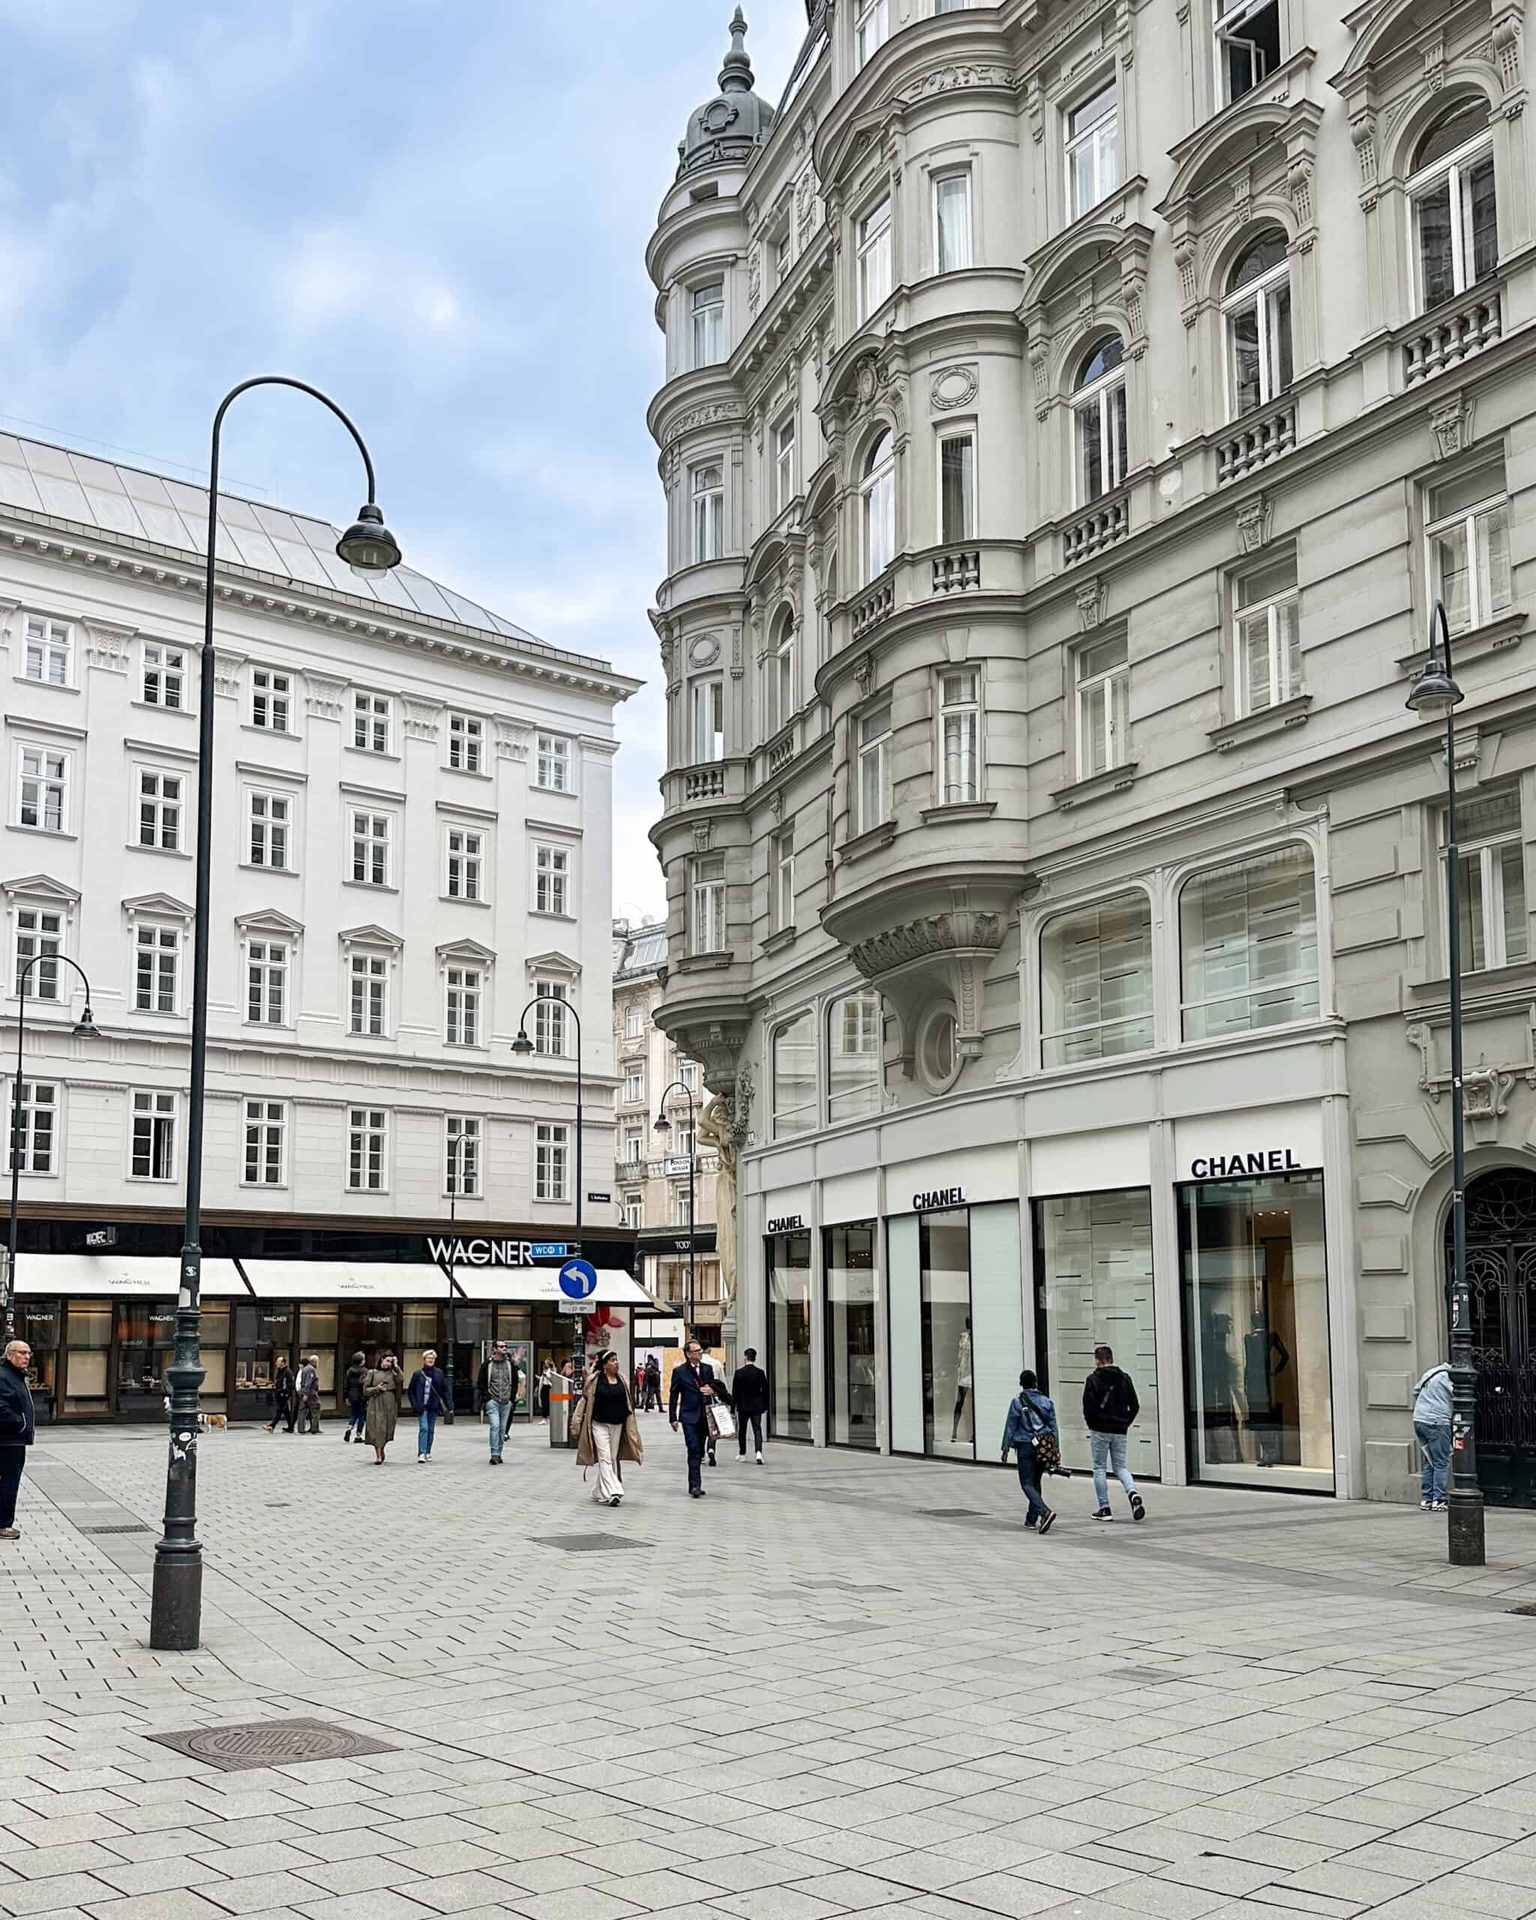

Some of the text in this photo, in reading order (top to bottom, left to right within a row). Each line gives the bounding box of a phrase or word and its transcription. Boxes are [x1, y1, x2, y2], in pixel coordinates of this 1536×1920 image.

[1190, 1149, 1301, 1178] CHANEL
[912, 1187, 966, 1210] CHANEL
[767, 1215, 804, 1233] CHANEL
[427, 1237, 534, 1265] WAGNER
